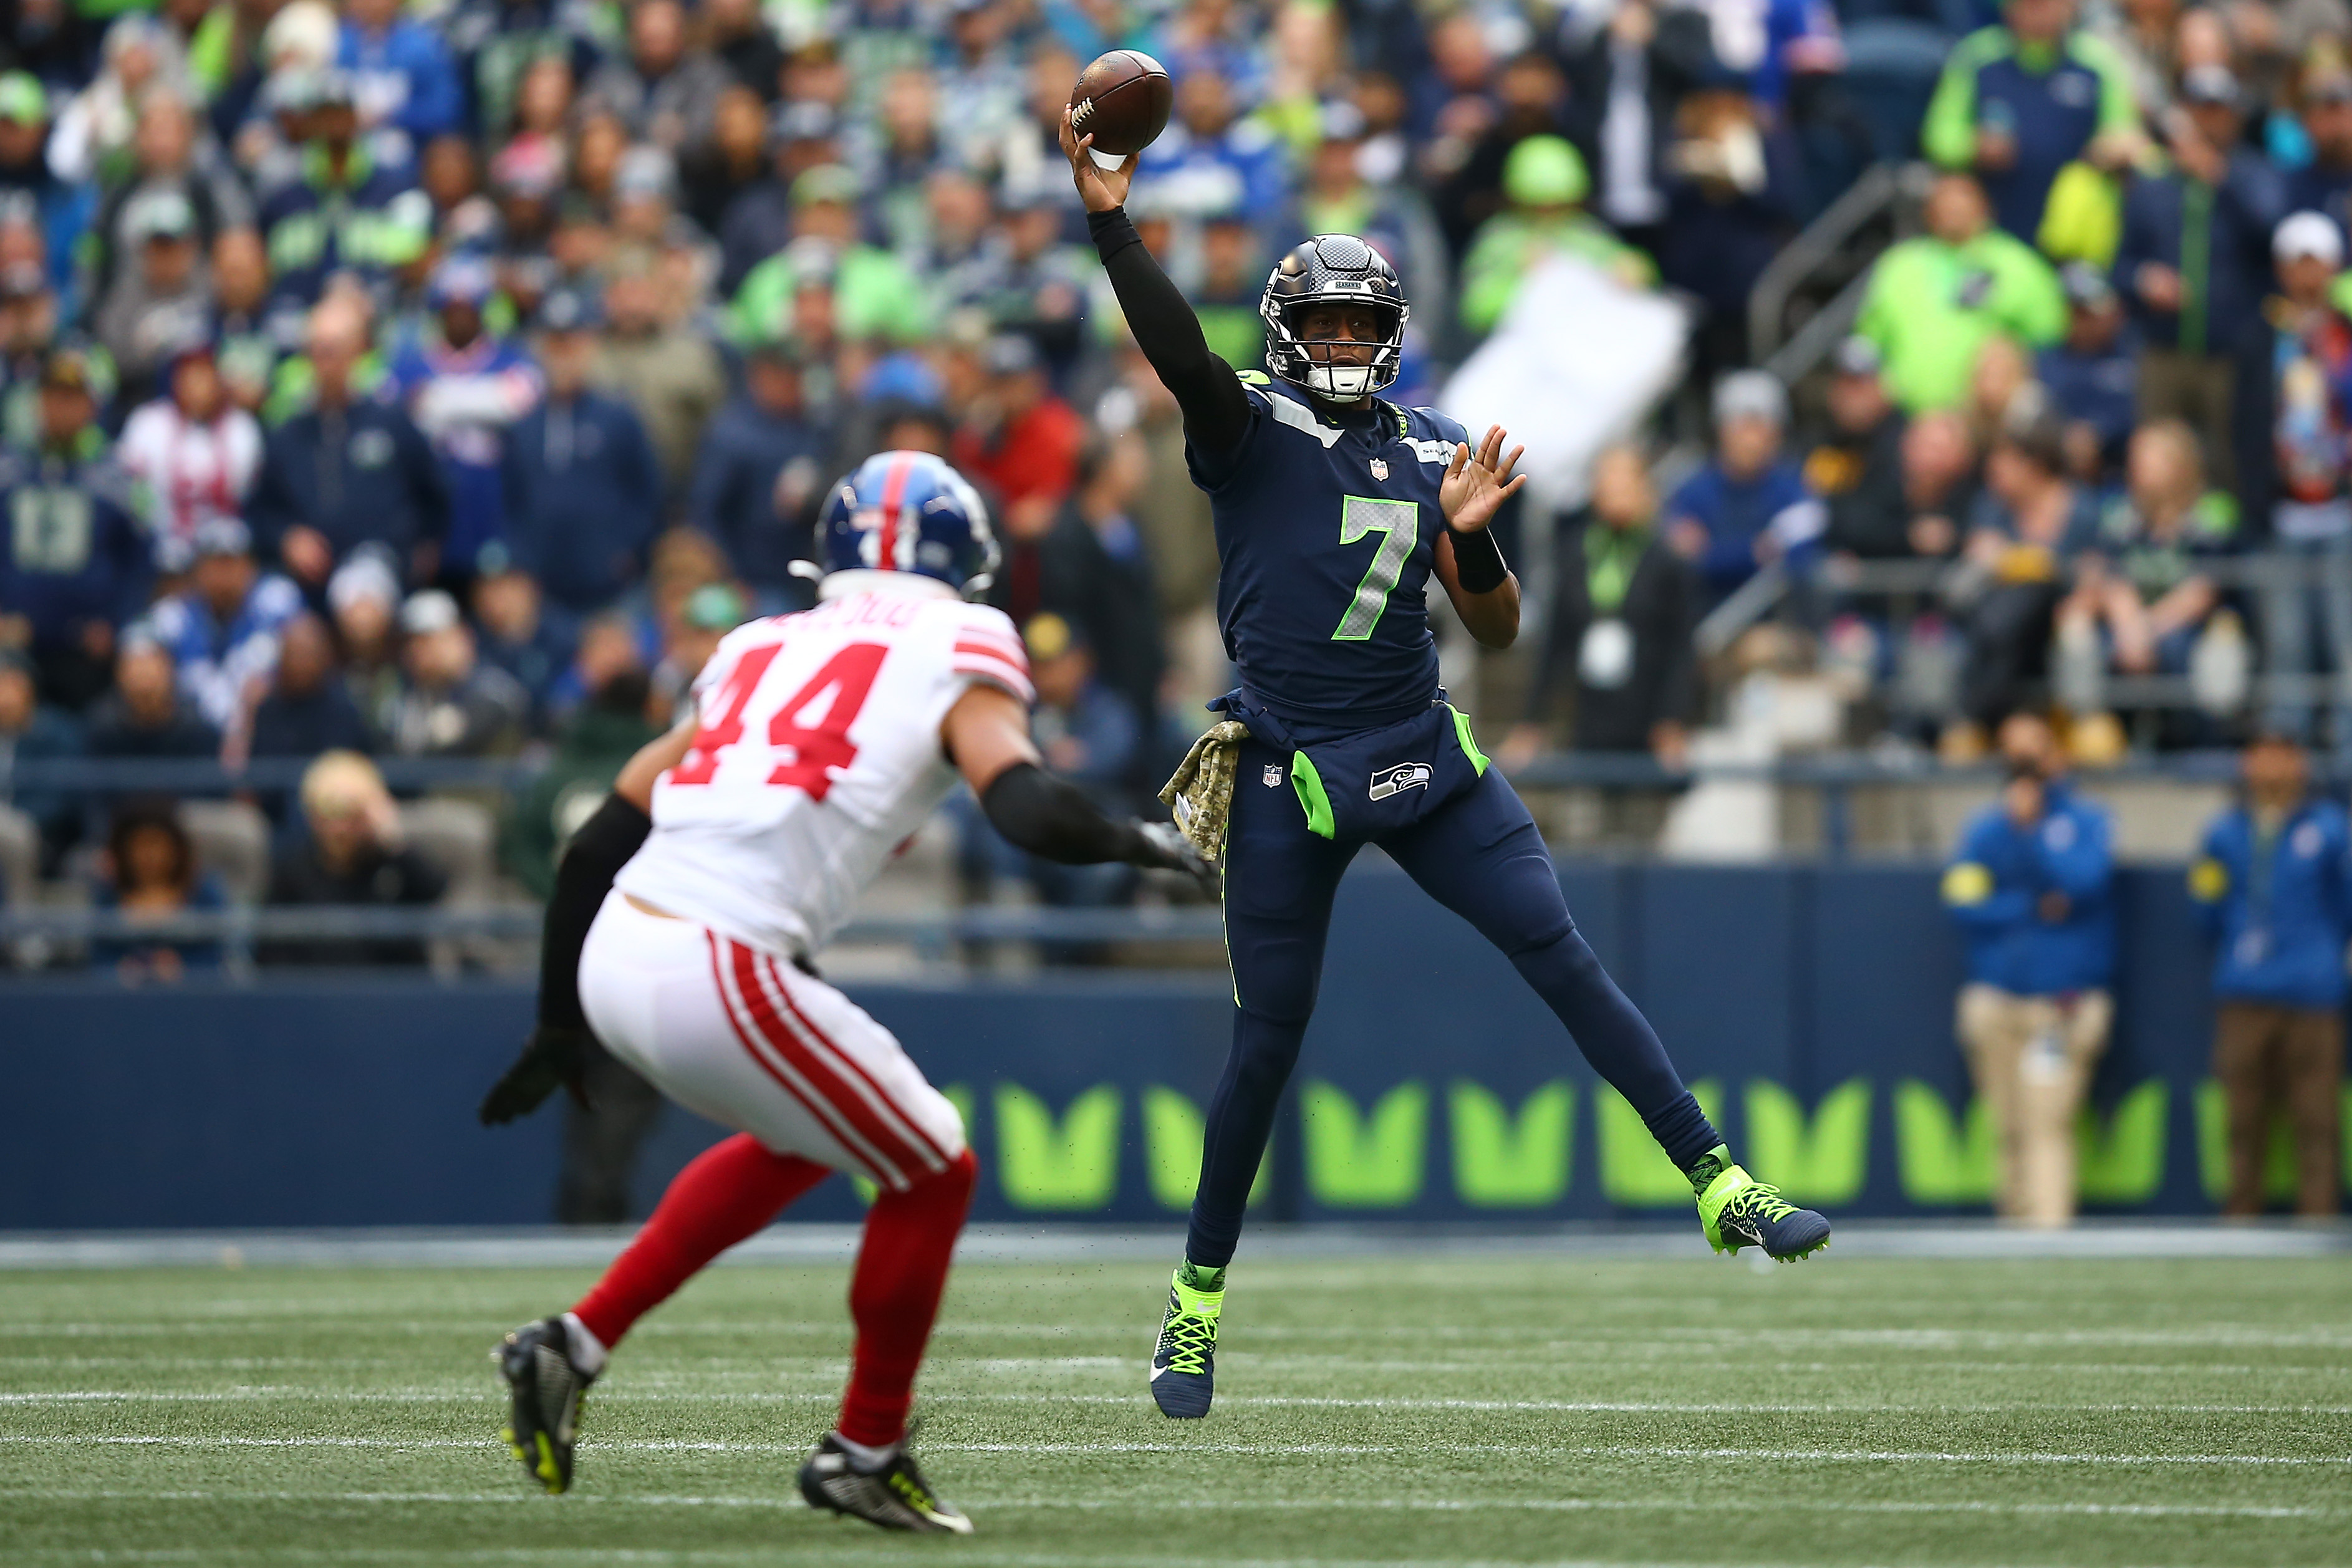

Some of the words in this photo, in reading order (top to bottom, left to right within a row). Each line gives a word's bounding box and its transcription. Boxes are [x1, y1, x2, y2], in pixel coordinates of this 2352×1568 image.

[1331, 494, 1419, 640] 7
[669, 640, 889, 802] 44
[1266, 774, 1278, 783] NFL
